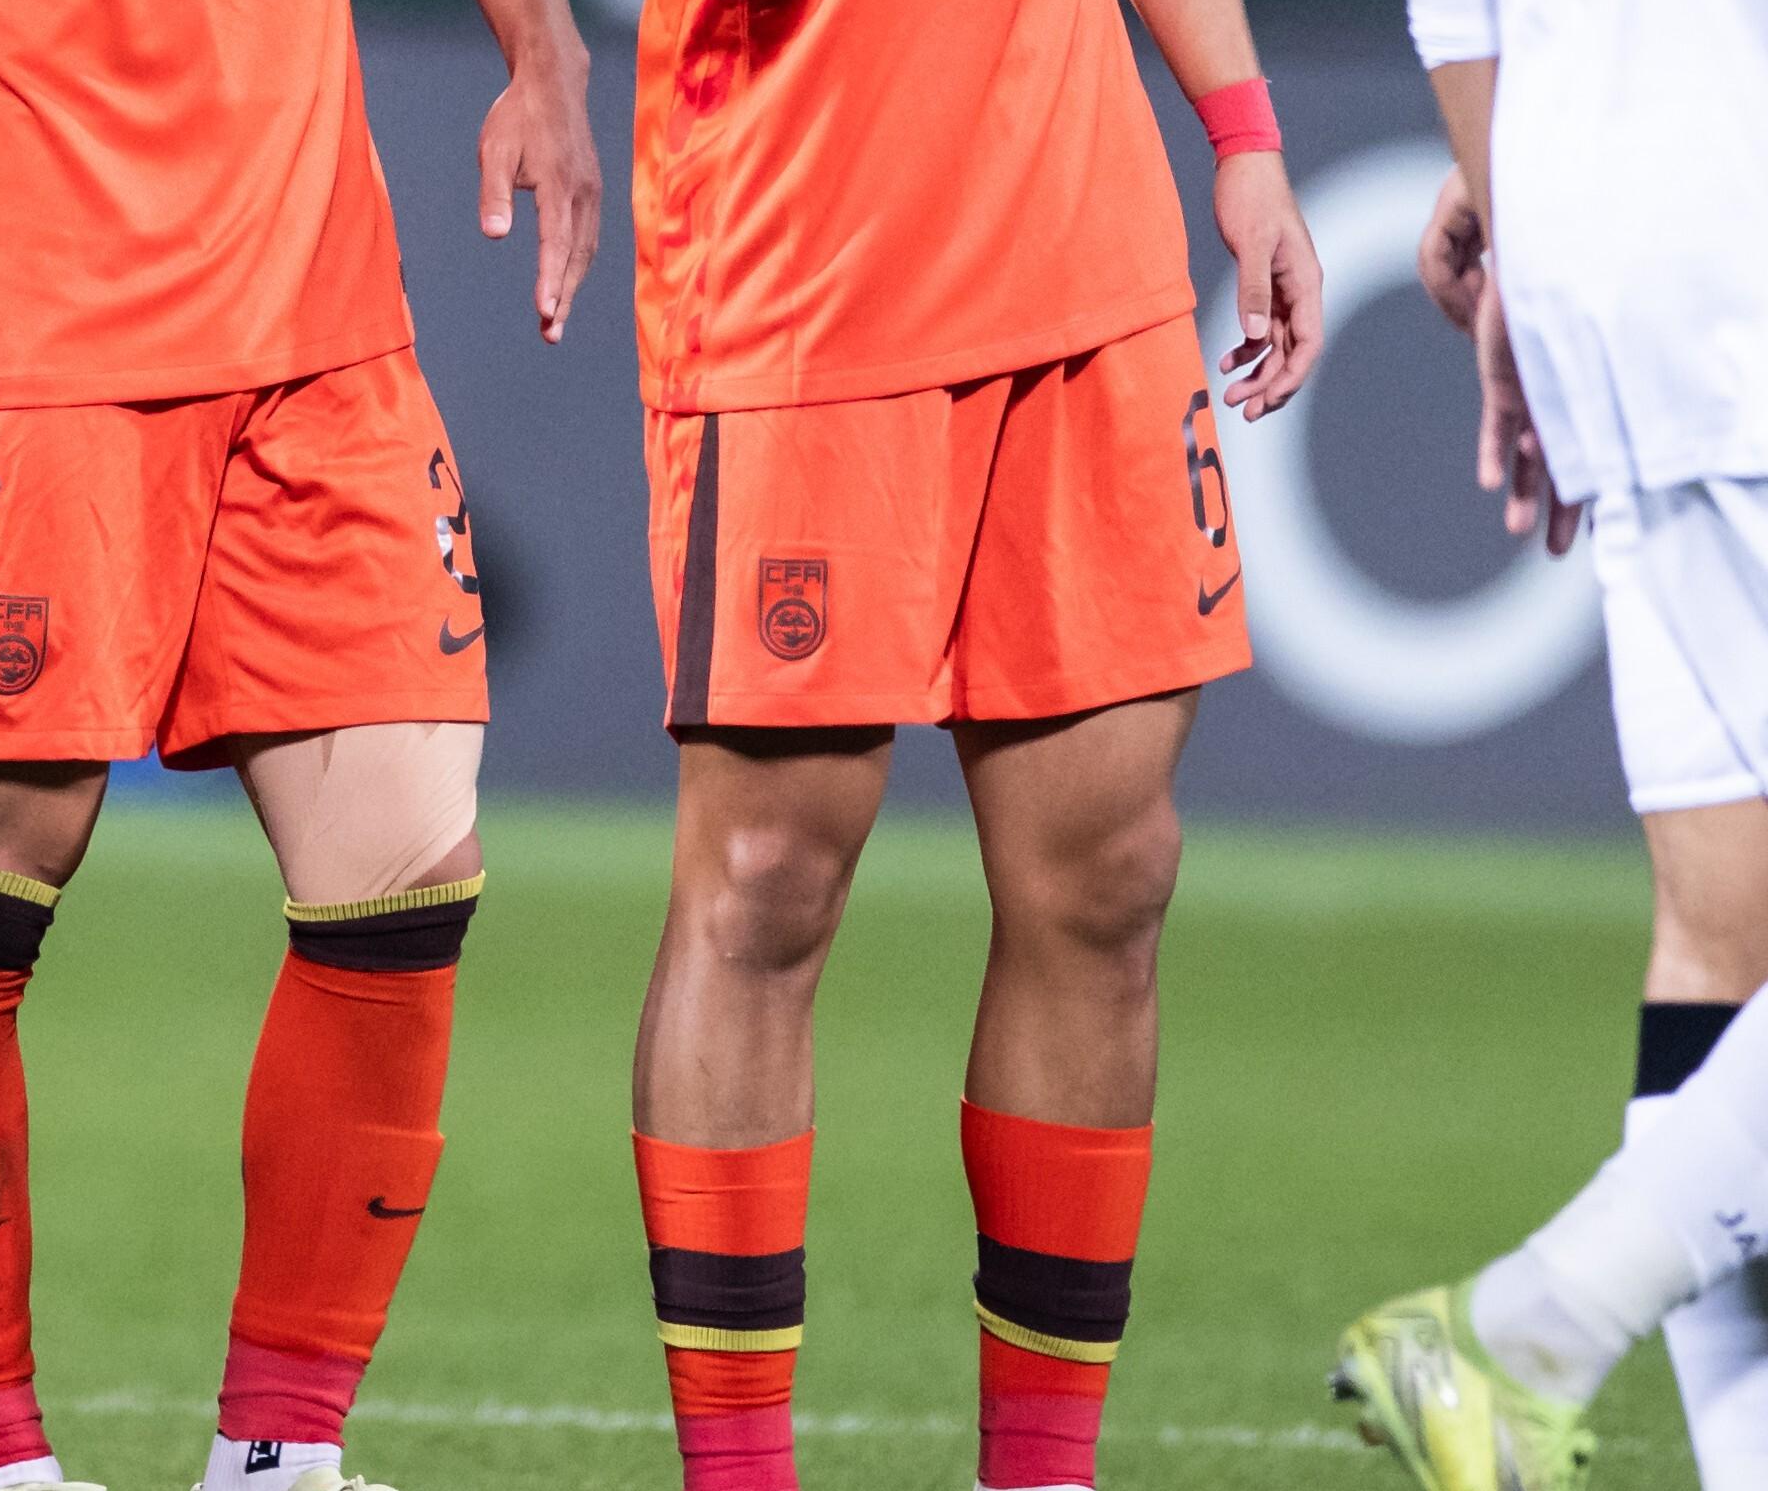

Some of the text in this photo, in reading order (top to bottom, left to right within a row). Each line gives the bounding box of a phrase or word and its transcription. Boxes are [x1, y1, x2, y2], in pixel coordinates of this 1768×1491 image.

[428, 447, 479, 594] 2
[1183, 388, 1228, 548] 6
[765, 561, 821, 584] CFA
